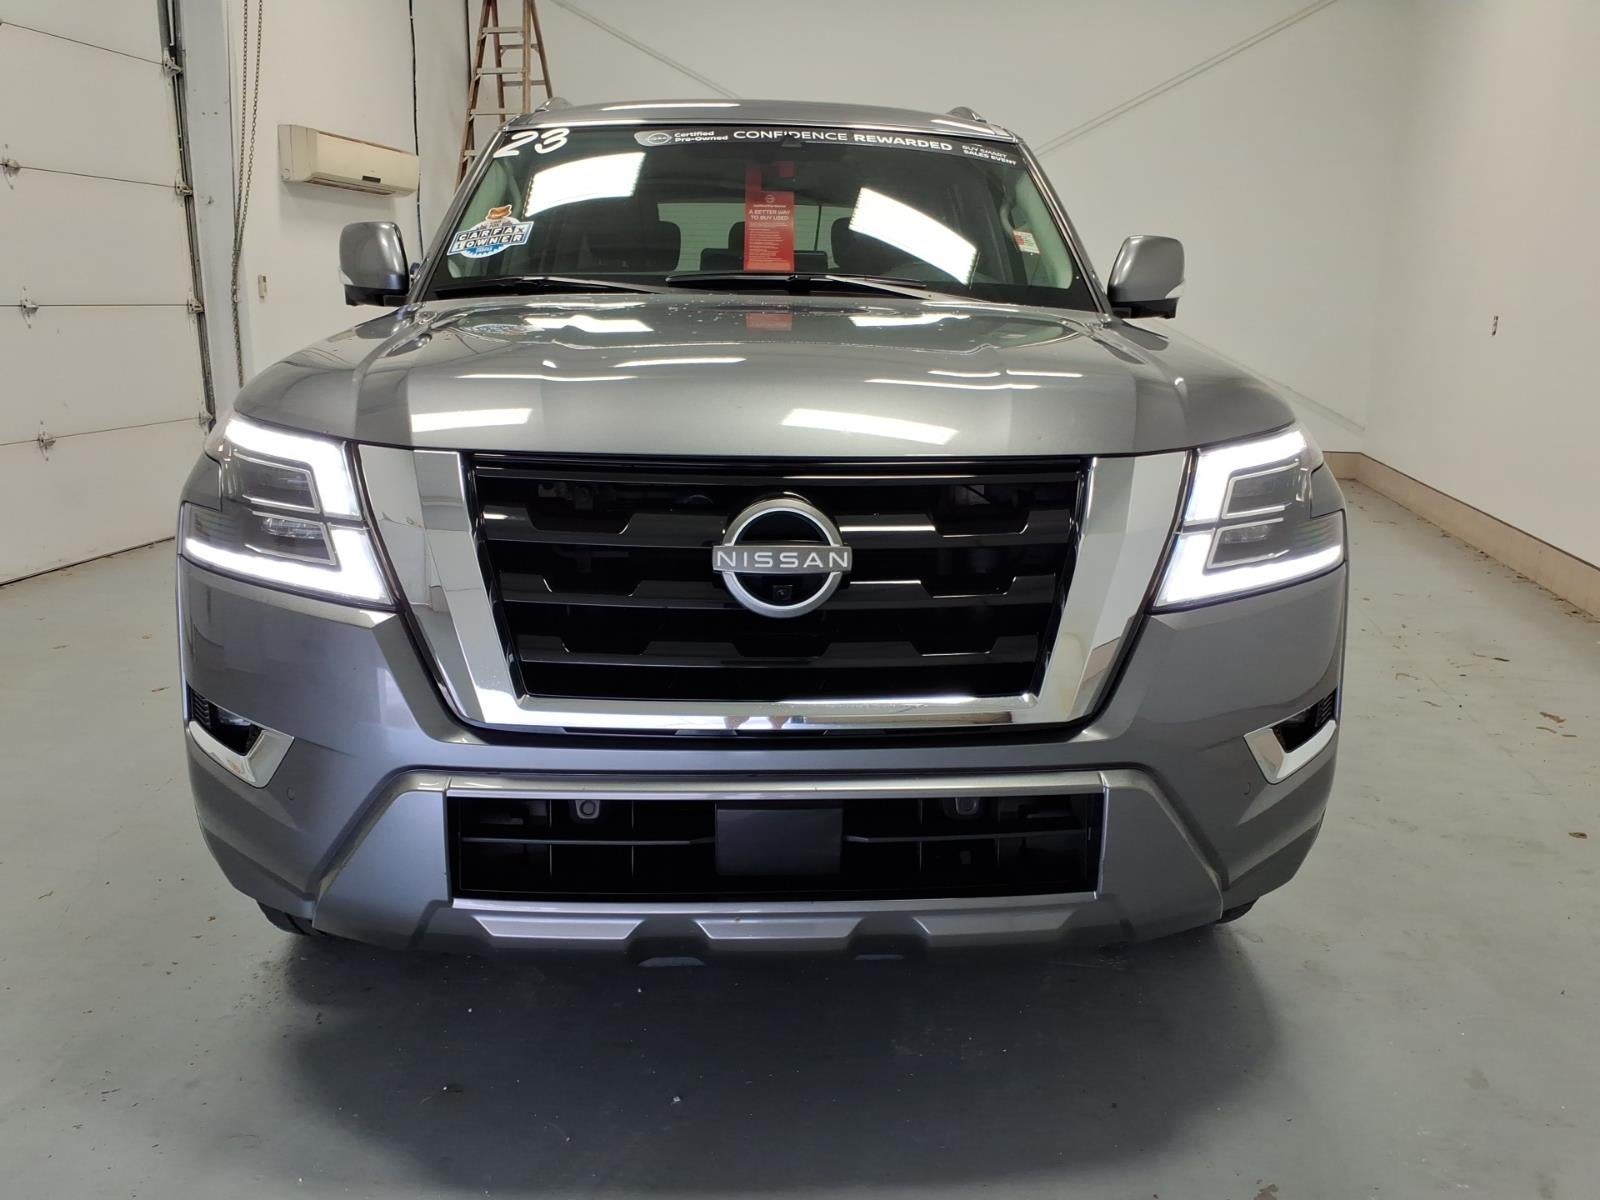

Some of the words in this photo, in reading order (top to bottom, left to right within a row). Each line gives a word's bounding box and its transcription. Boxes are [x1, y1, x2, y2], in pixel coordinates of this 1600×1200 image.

[493, 128, 570, 158] 23
[733, 130, 848, 141] CONFIDENCE
[853, 134, 953, 151] REWARDED
[963, 149, 989, 159] SALES
[990, 155, 1017, 166] EVENT
[458, 225, 525, 241] CARFAX
[466, 234, 523, 248] OWNER
[717, 551, 848, 568] NISSAN
